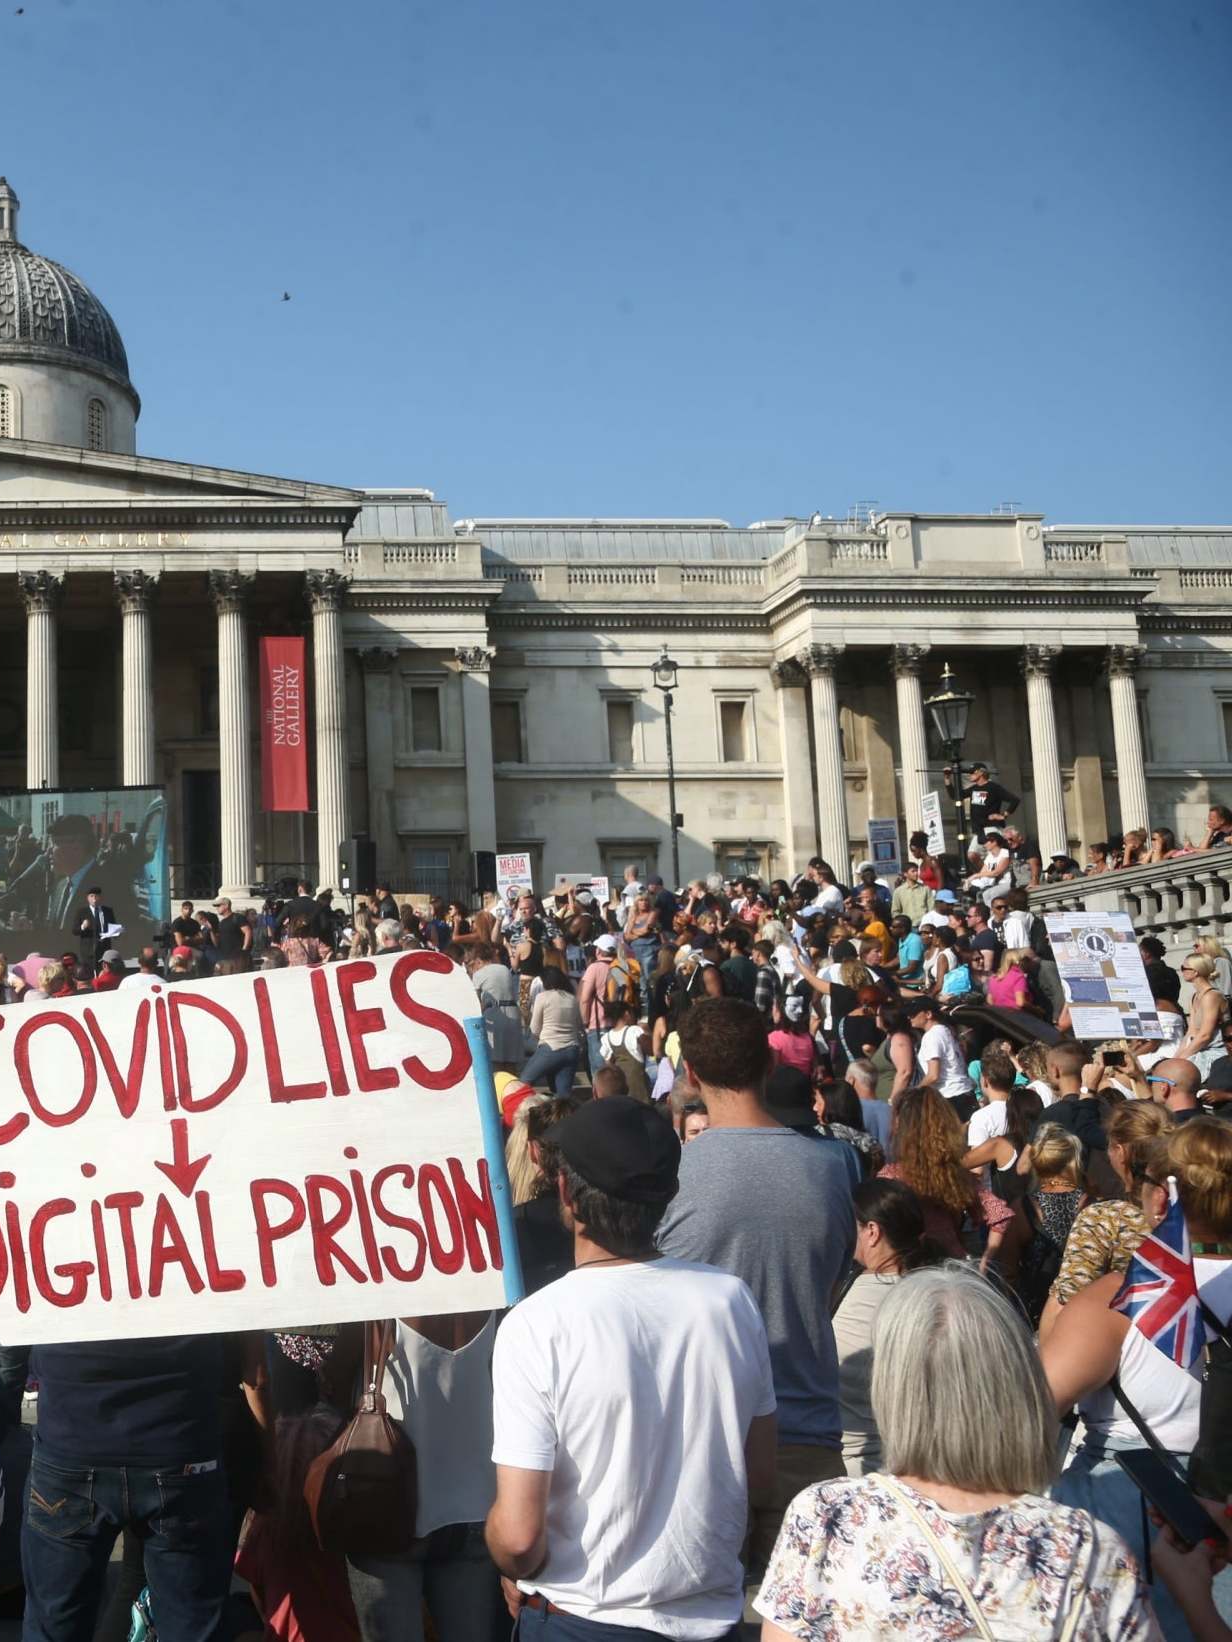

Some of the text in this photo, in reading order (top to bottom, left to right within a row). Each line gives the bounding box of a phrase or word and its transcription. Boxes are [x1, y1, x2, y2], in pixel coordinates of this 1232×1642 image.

[53, 532, 193, 548] GALLERY
[273, 664, 285, 745] NATIONAL
[286, 664, 300, 747] GALLERY
[253, 951, 473, 1104] LIES
[249, 1145, 504, 1288] PRISON
